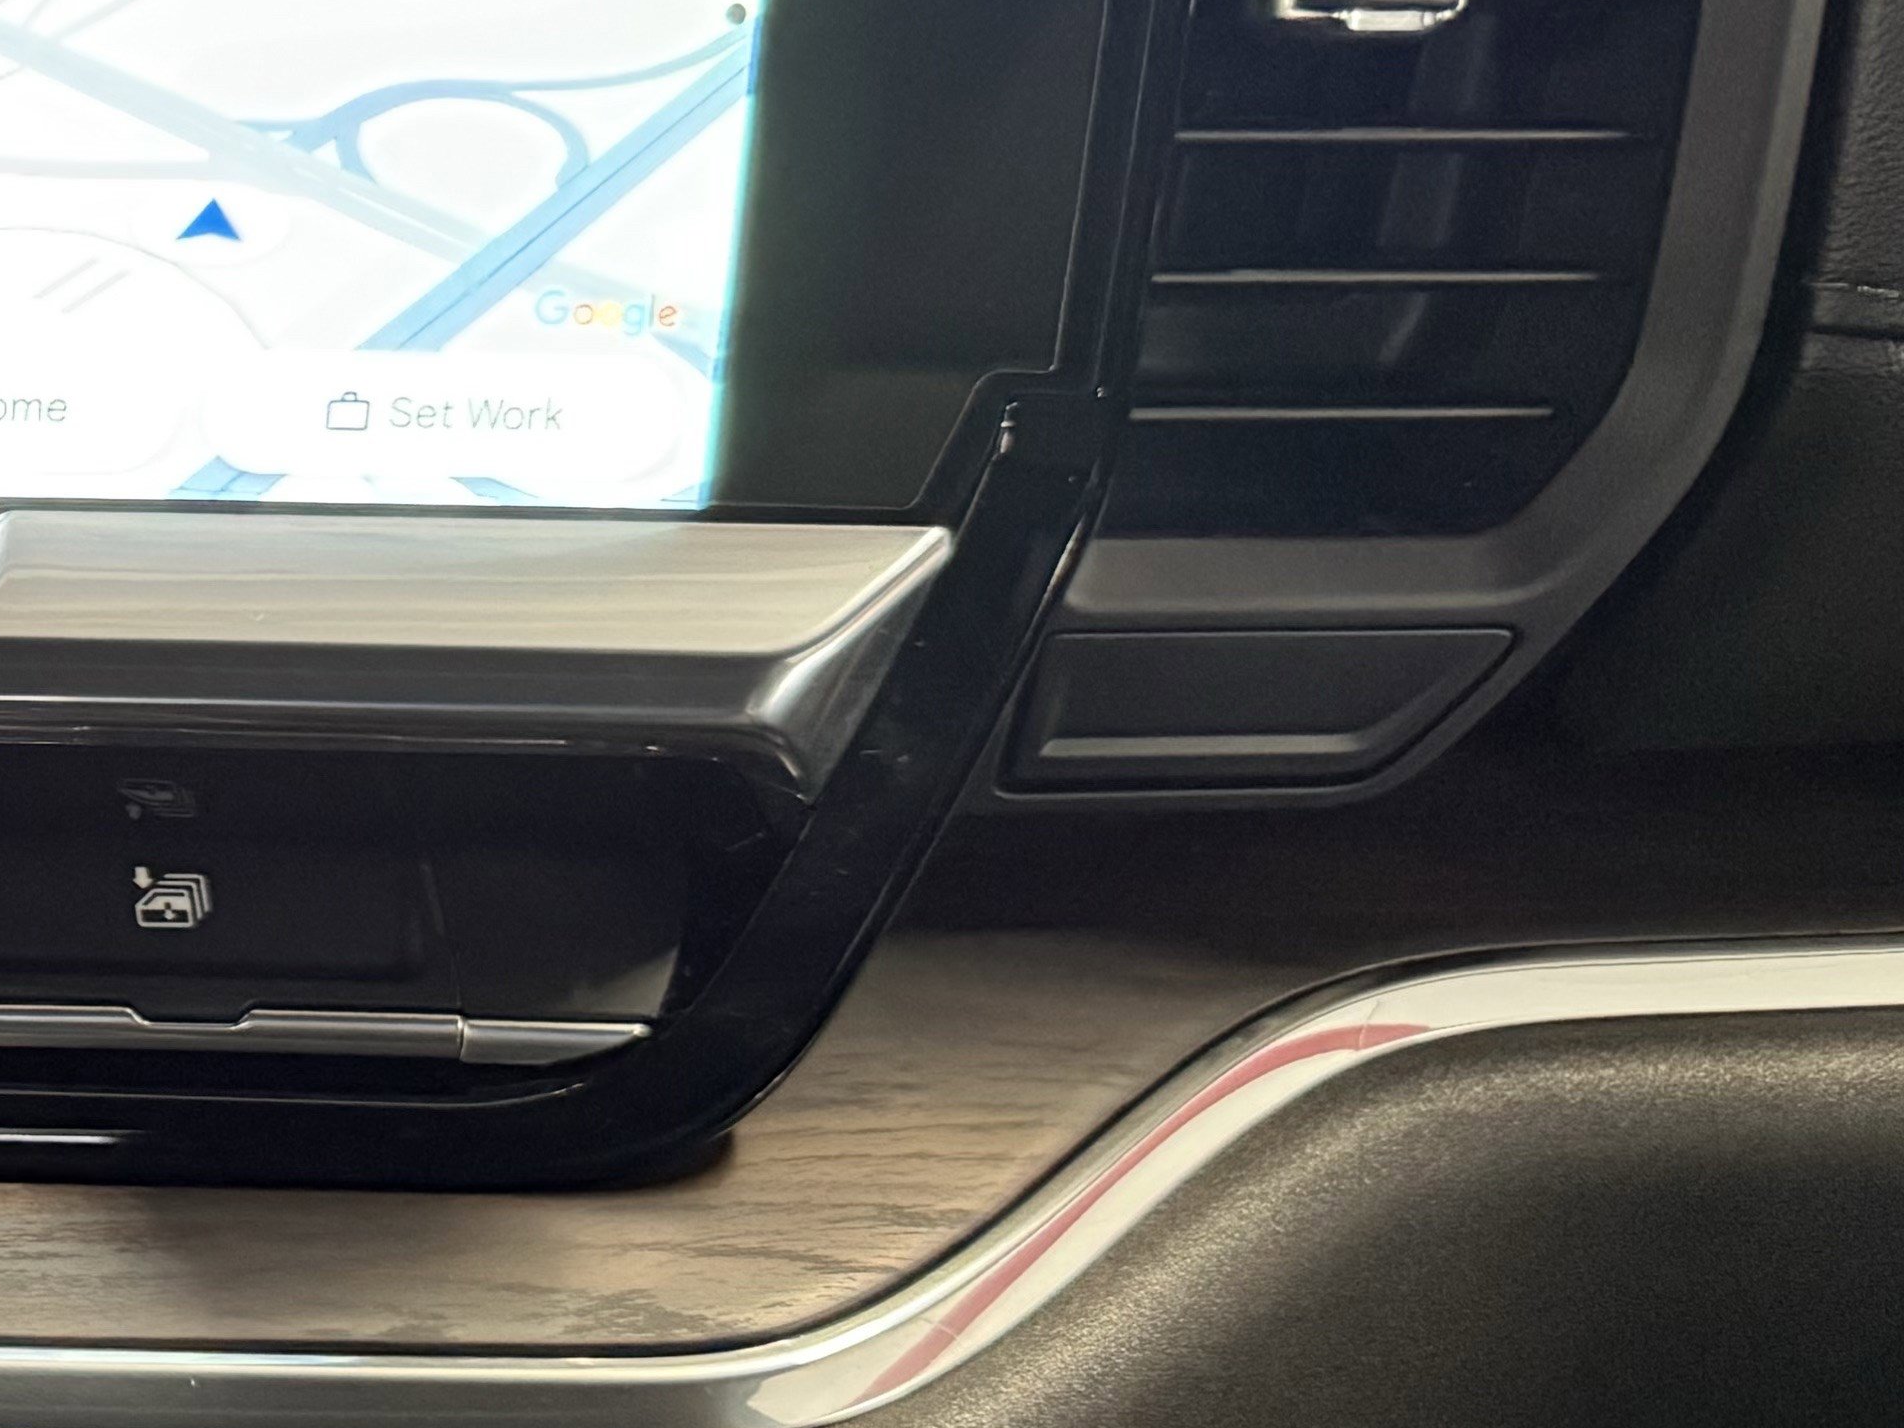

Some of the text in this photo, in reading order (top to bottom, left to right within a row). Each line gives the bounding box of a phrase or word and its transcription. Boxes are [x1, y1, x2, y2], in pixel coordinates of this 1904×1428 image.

[535, 288, 678, 336] Google
[389, 396, 563, 431] Set Work
